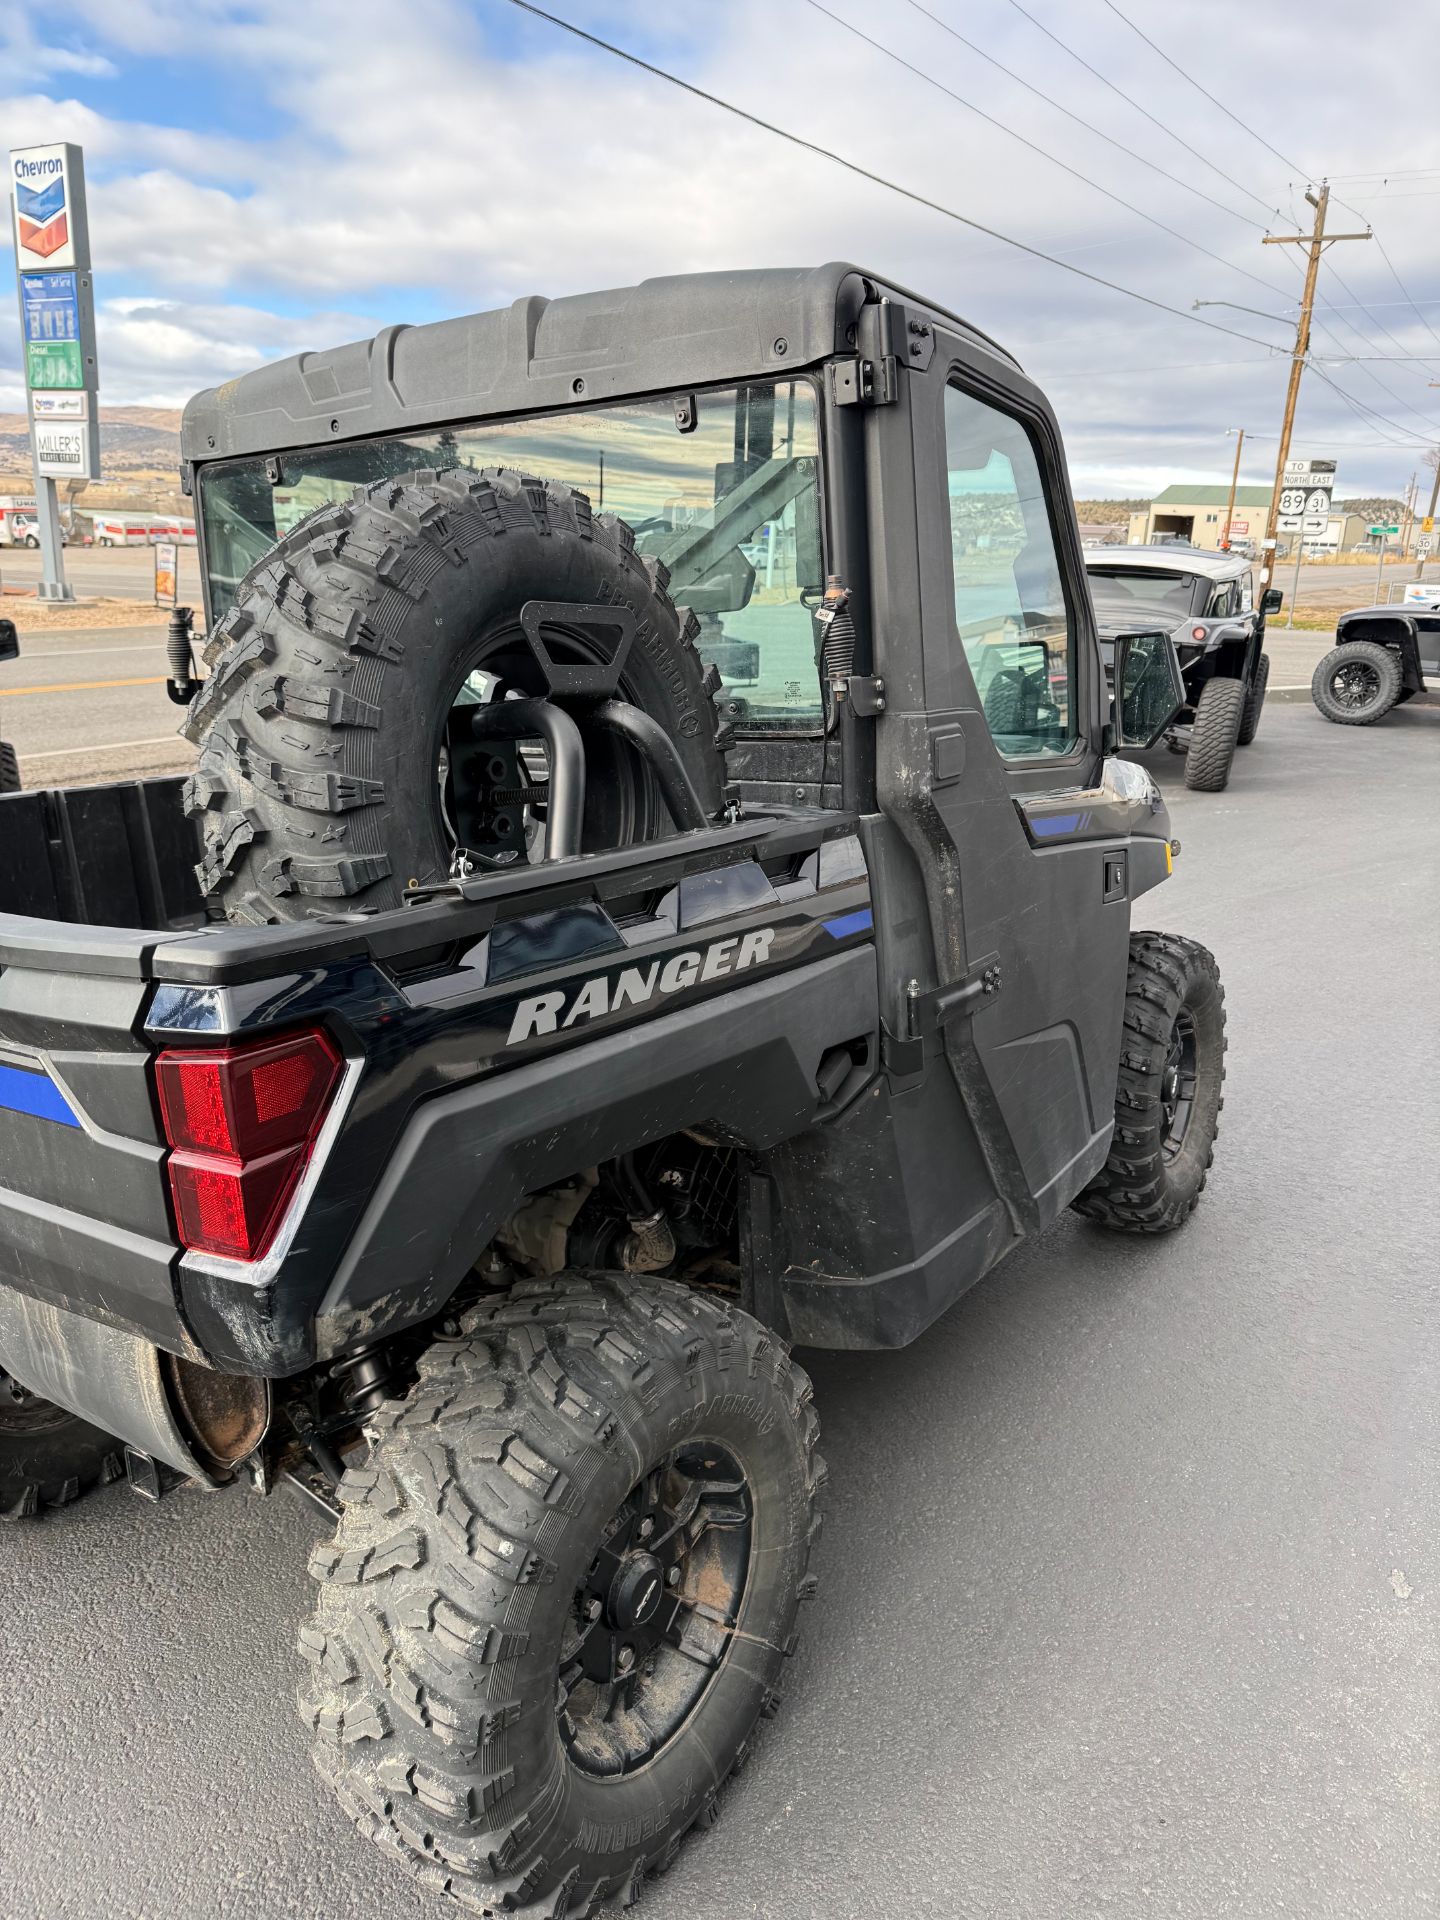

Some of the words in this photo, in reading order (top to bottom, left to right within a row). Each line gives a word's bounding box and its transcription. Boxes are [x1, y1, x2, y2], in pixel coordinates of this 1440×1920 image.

[14, 158, 63, 178] Chevron
[30, 344, 48, 355] Diesel
[38, 435, 80, 452] MILLER'S
[1292, 463, 1304, 471] TO
[1284, 476, 1307, 484] NORTH
[1312, 476, 1331, 484] EAST
[1282, 495, 1303, 508] 89
[1312, 498, 1324, 508] 31
[1418, 540, 1430, 548] 30
[505, 928, 775, 1046] RANGER
